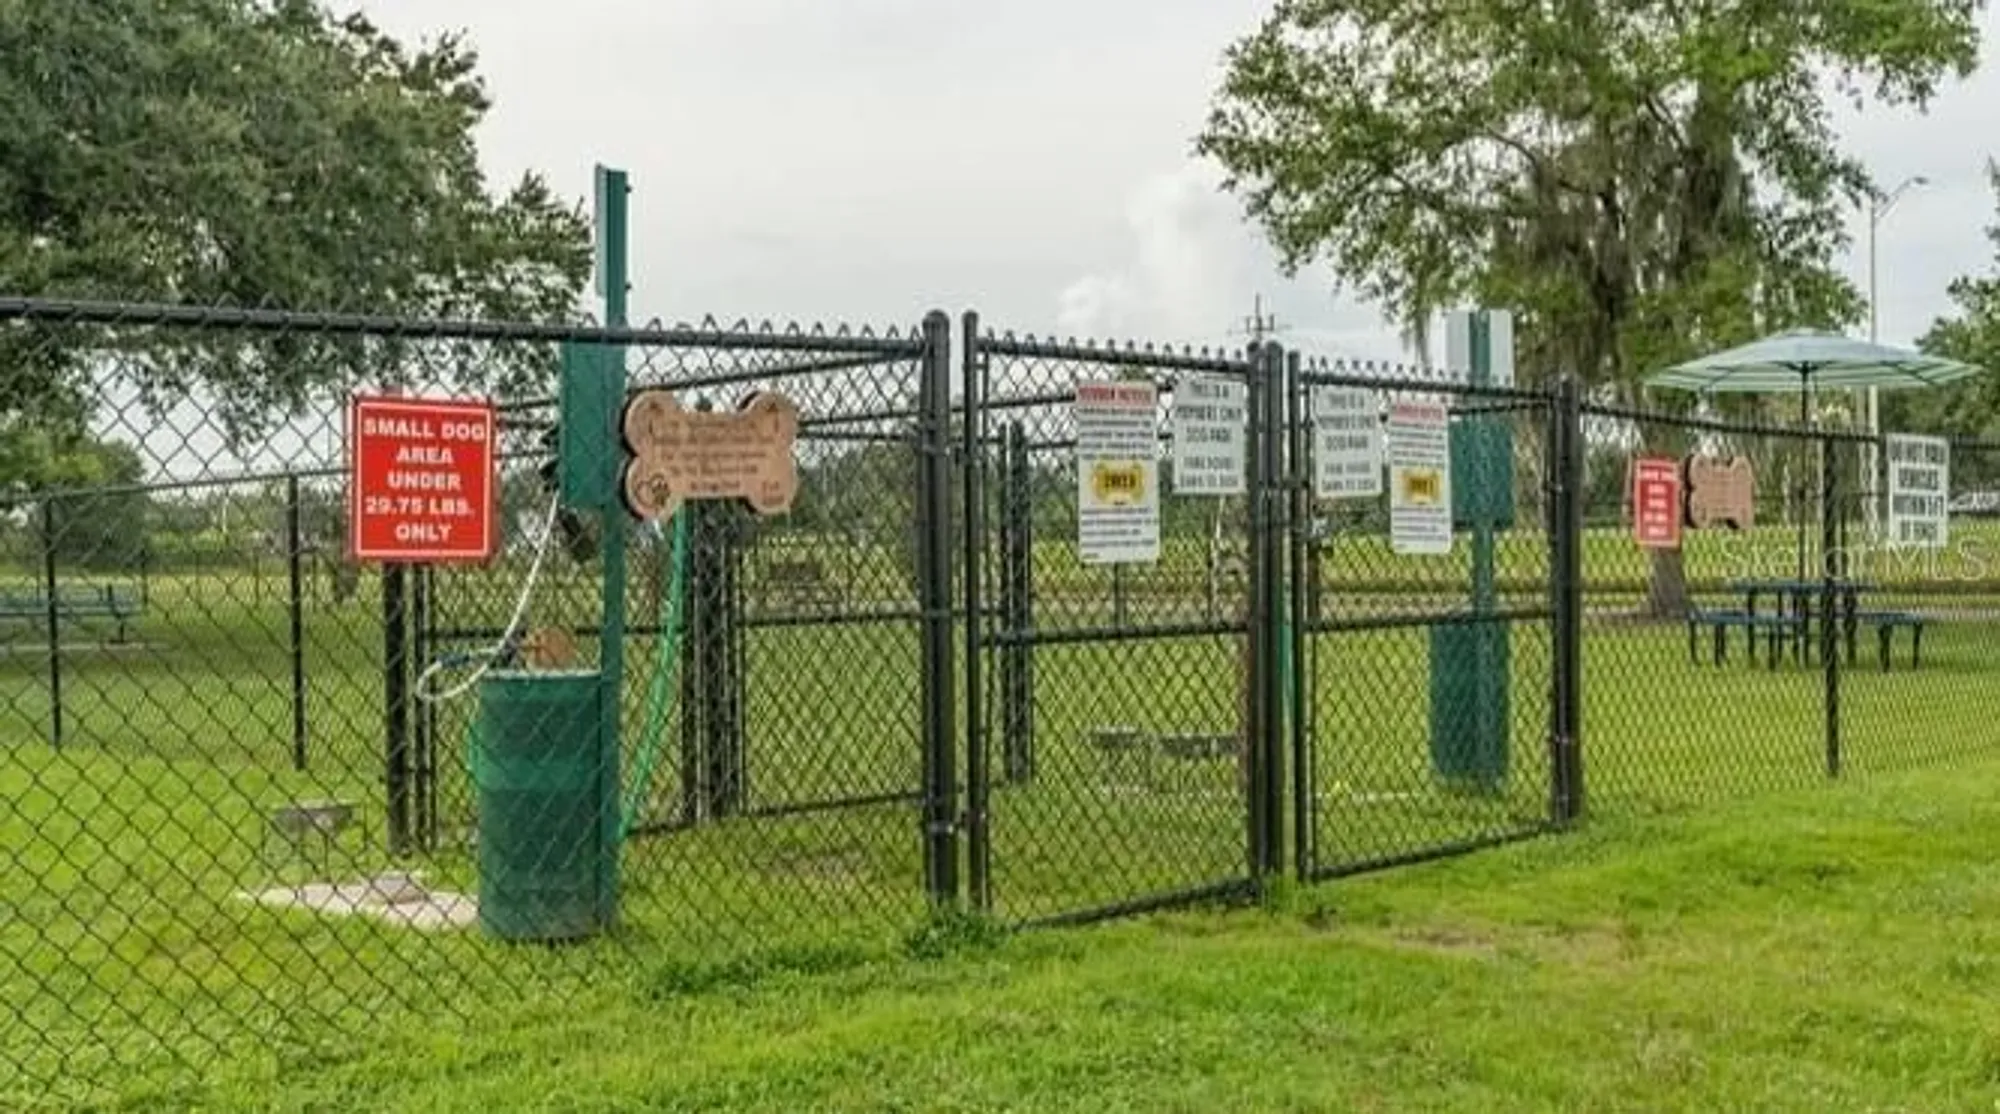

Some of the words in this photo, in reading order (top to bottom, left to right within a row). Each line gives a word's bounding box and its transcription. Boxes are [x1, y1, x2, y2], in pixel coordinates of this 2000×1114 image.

[363, 418, 435, 439] SMALL
[441, 422, 485, 442] DOG
[396, 446, 454, 464] AREA
[387, 470, 461, 491] UNDER
[364, 496, 423, 516] 29.75
[429, 497, 475, 517] LBS.
[394, 522, 452, 542] ONLY
